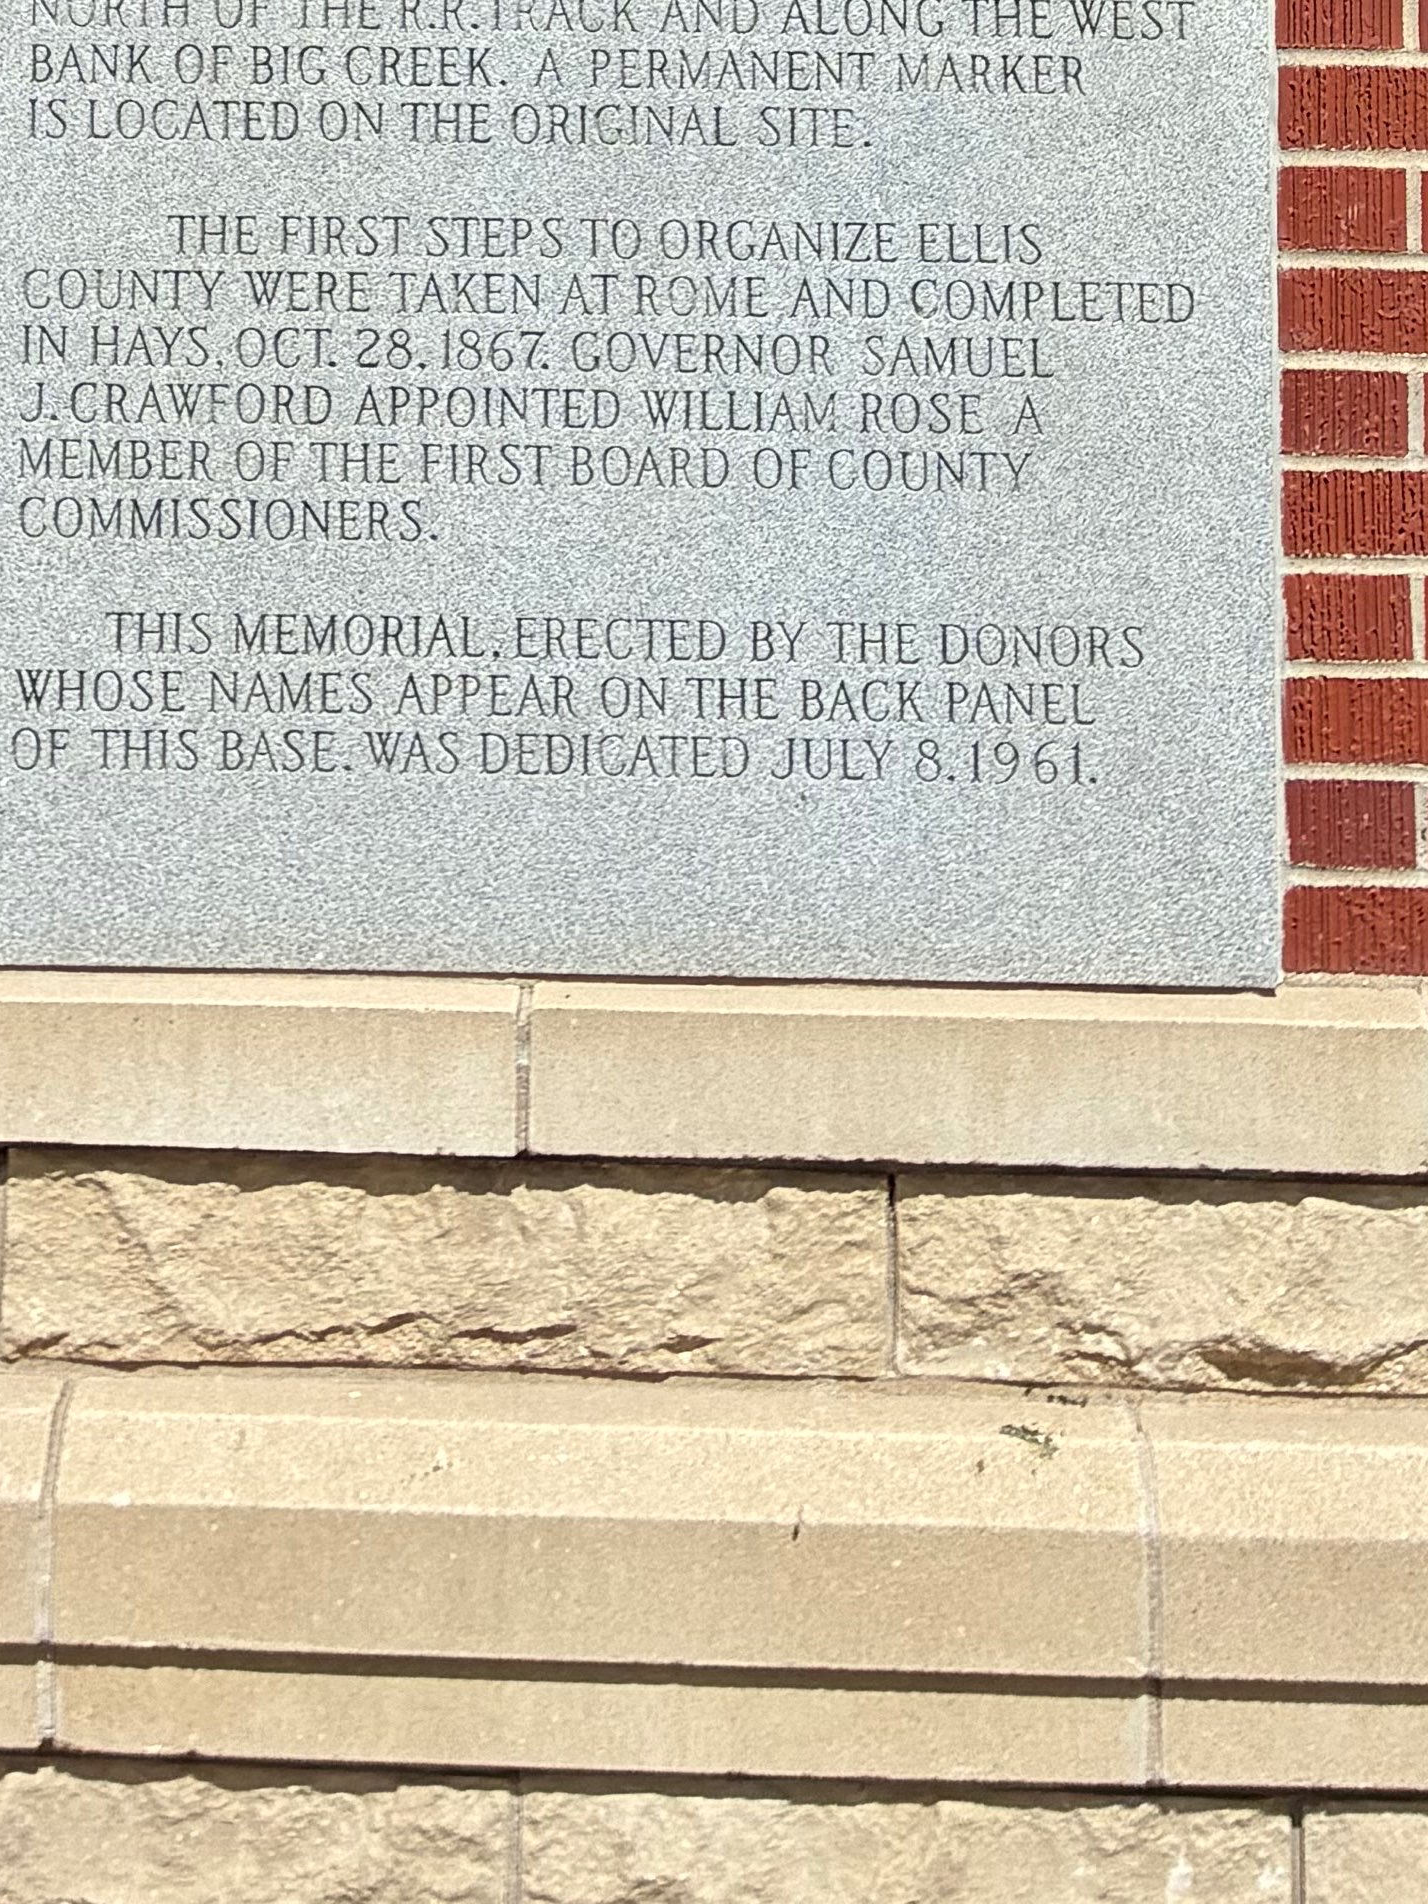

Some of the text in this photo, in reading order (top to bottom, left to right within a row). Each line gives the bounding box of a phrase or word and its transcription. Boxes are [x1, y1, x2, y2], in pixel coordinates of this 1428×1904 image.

[1072, 0, 1194, 41] WEST
[30, 43, 1085, 95] BANK OF BIG CREEK. A PERMANENT MARKER
[29, 98, 873, 148] IS LOCATED ON THE ORIGINAL SITE.
[168, 215, 1043, 264] THE FIRST STEPS TO ORGANIZE ELLIS
[22, 269, 1195, 324] COUNTY WERE TAKEN AT ROME AND COMPLETED
[21, 325, 67, 365] IN
[236, 327, 337, 369] OCT.
[441, 329, 550, 372] 1867.
[572, 331, 832, 374] GOVERNOR
[862, 335, 1055, 378] SAMUEL
[20, 382, 1044, 435] J. CRAWFORD APPOINTED WILLIAM ROSE A
[18, 439, 1032, 492] MEMBER OF THE FIRST BOARD OF COUNTY
[19, 496, 439, 542] COMMISSIONERS.
[105, 611, 212, 654] THIS
[515, 617, 727, 662] ERECTED
[750, 621, 808, 662] BY
[827, 622, 922, 664] THE
[938, 623, 1145, 668] DONORS
[15, 669, 1095, 725] WHOSE NAMES APPEAR ON THE BACK PANEL
[11, 728, 70, 770] OF
[91, 728, 198, 771] THIS
[364, 731, 460, 774] WAS
[479, 733, 750, 779] DEDICATED
[772, 737, 895, 781] JULY
[971, 739, 1098, 785] 1961.
